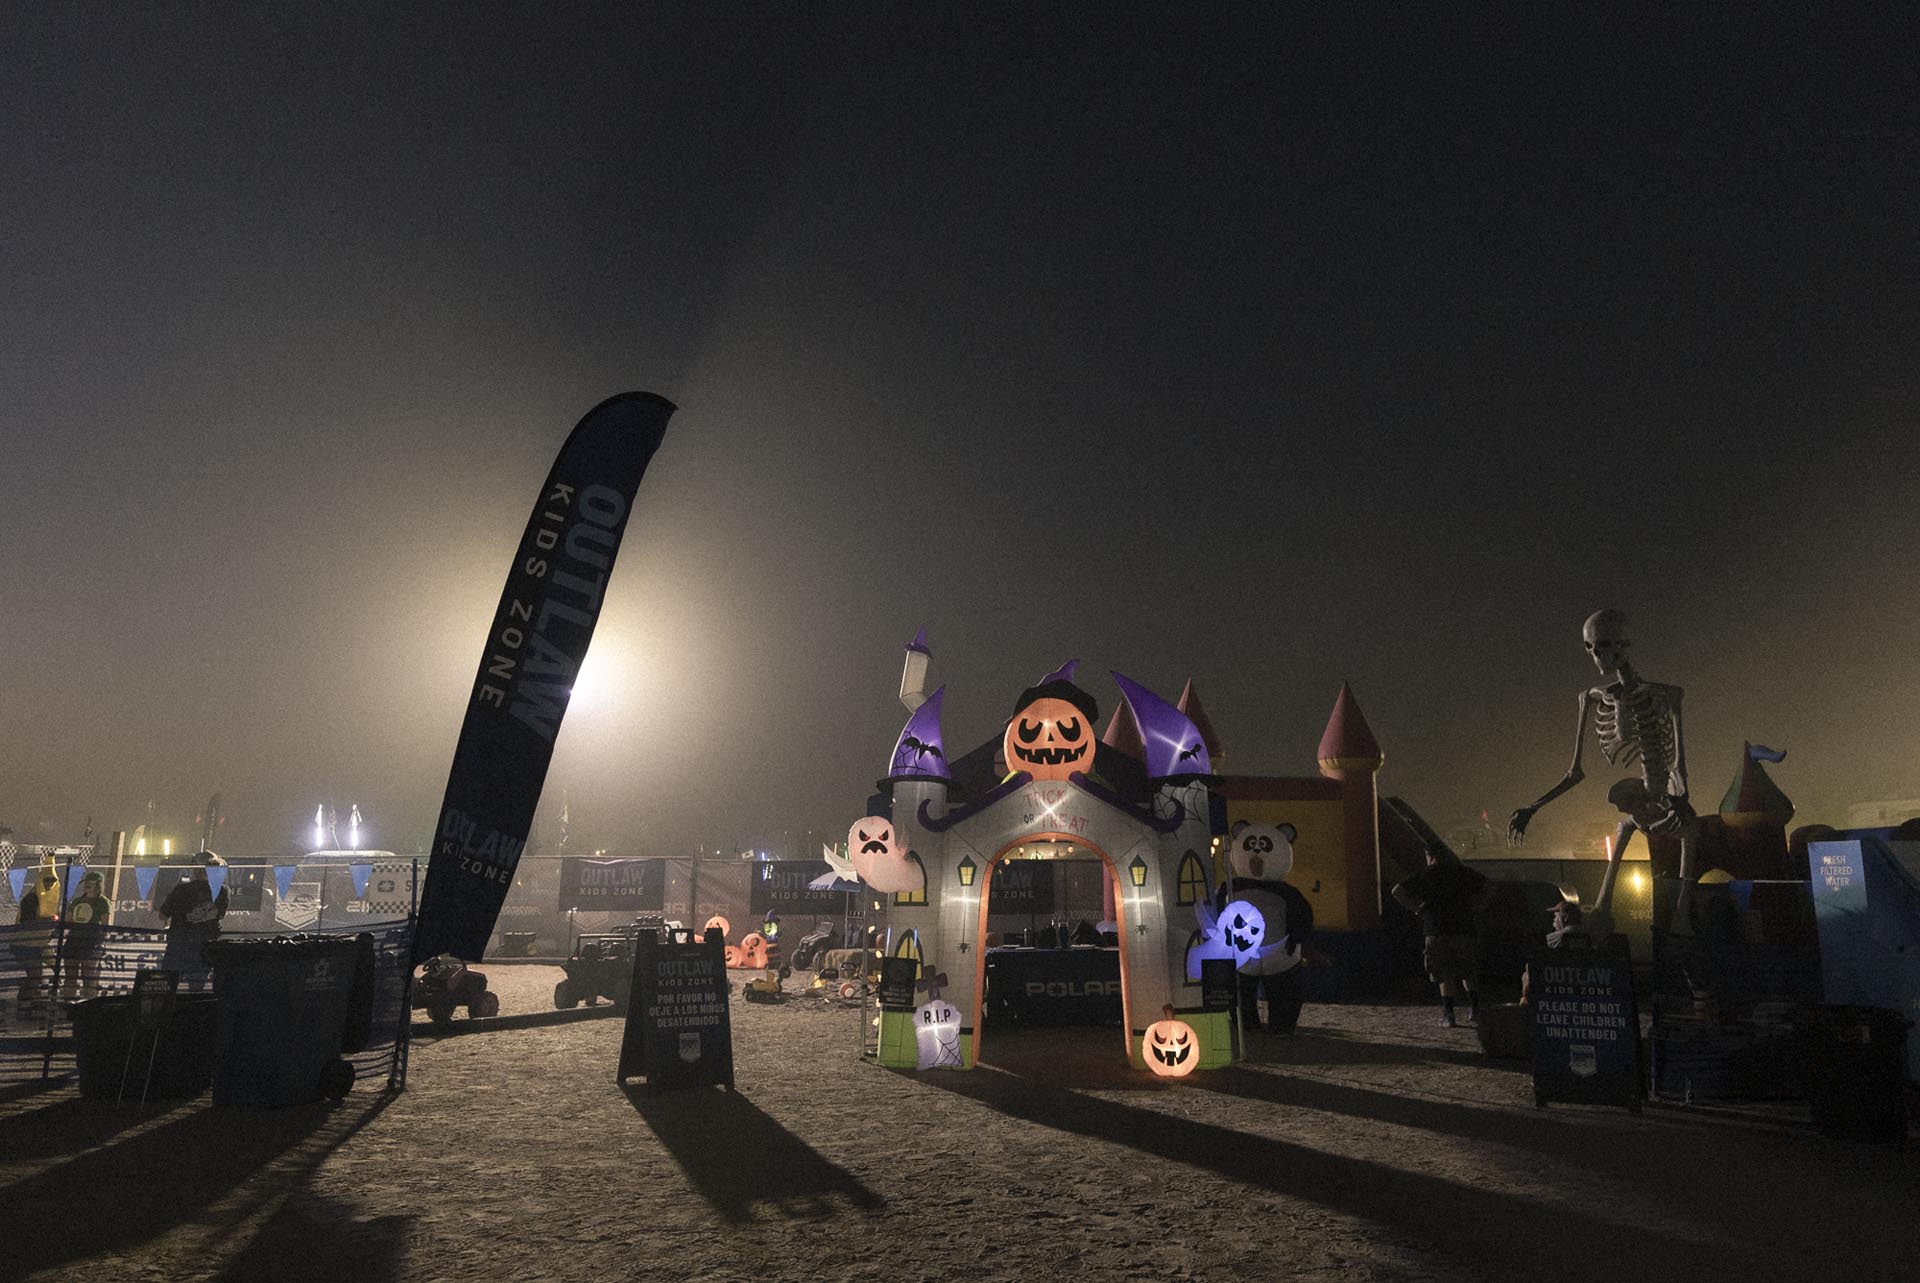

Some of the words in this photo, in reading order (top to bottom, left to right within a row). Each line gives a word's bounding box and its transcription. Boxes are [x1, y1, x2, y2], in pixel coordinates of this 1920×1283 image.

[525, 482, 575, 578] KIDS
[509, 483, 626, 743] OUTLAW
[480, 599, 533, 708] ZONE
[460, 856, 510, 885] ZONE
[580, 866, 645, 886] OUTLAW
[578, 887, 608, 896] KIDS
[613, 887, 644, 896] ZONE
[770, 892, 799, 900] KIDS
[804, 892, 835, 900] ZONE
[657, 959, 714, 977] OUTLAW
[1544, 967, 1612, 985] OUTLAW
[676, 993, 703, 1004] FAVOR
[704, 992, 717, 1002] NO
[1544, 986, 1575, 994] KIDS
[1580, 987, 1613, 996] ZONE
[649, 1006, 672, 1016] DEJE
[673, 1005, 680, 1015] A
[681, 1004, 698, 1015] LOS
[1538, 1000, 1579, 1013] PLEASE
[1581, 1002, 1597, 1013] DO
[1599, 1003, 1622, 1014] NOT
[1536, 1013, 1570, 1025] LEAVE
[1572, 1015, 1626, 1029] CHILDREN
[1546, 1026, 1618, 1041] UNATTENDED
